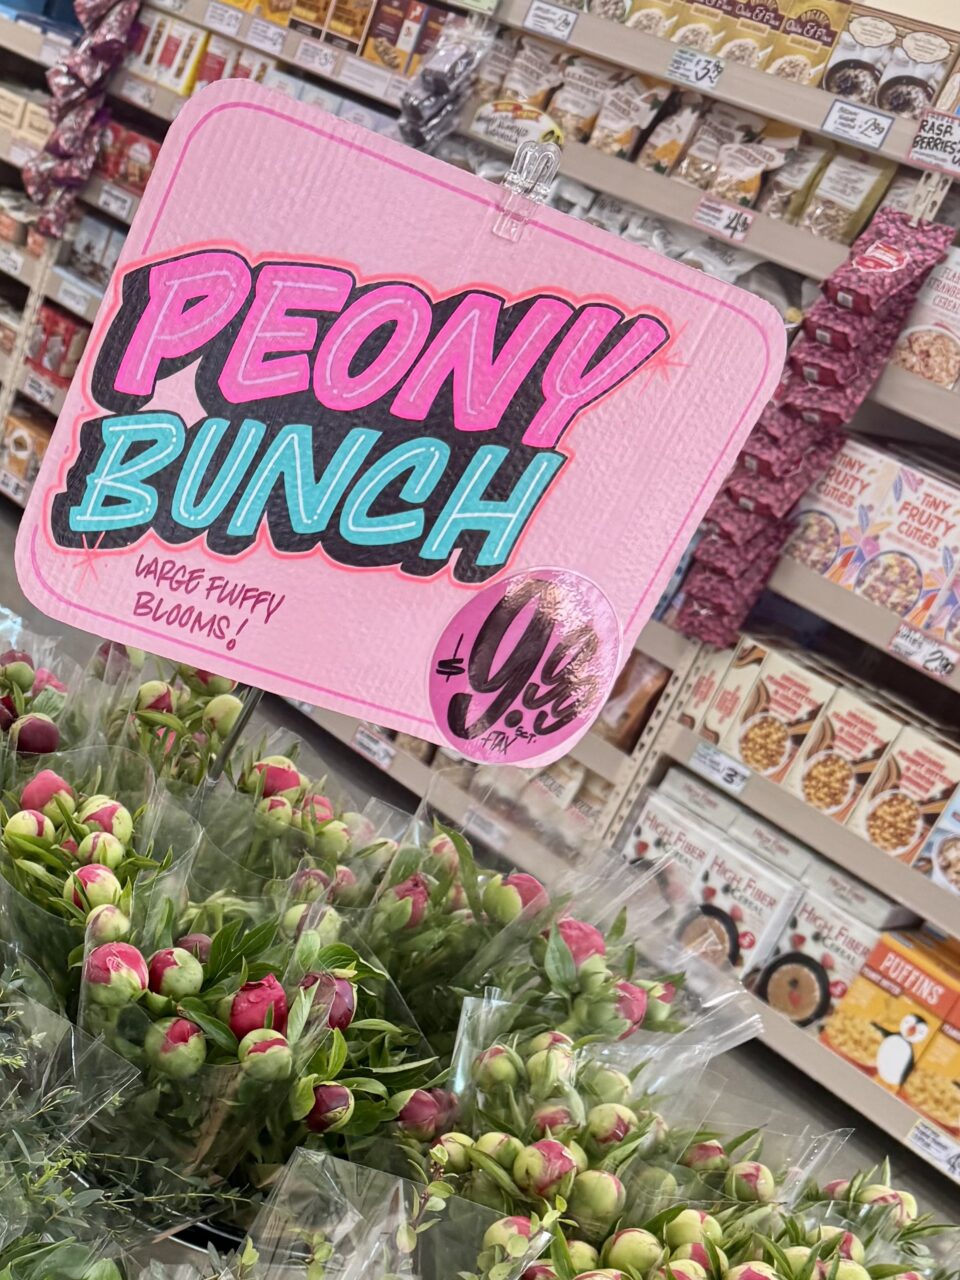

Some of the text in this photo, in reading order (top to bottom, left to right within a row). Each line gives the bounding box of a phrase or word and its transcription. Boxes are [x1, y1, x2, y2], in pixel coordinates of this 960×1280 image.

[112, 249, 670, 449] PEONY
[69, 412, 567, 567] BUNCH
[135, 554, 286, 625] LARGE FLUFFY
[132, 591, 249, 651] BLOOMS!
[641, 811, 707, 861] HIGH FIBER
[711, 855, 778, 908] HIGH FIBER
[798, 902, 833, 935] HIGH
[879, 951, 945, 1006] PUFFINS
